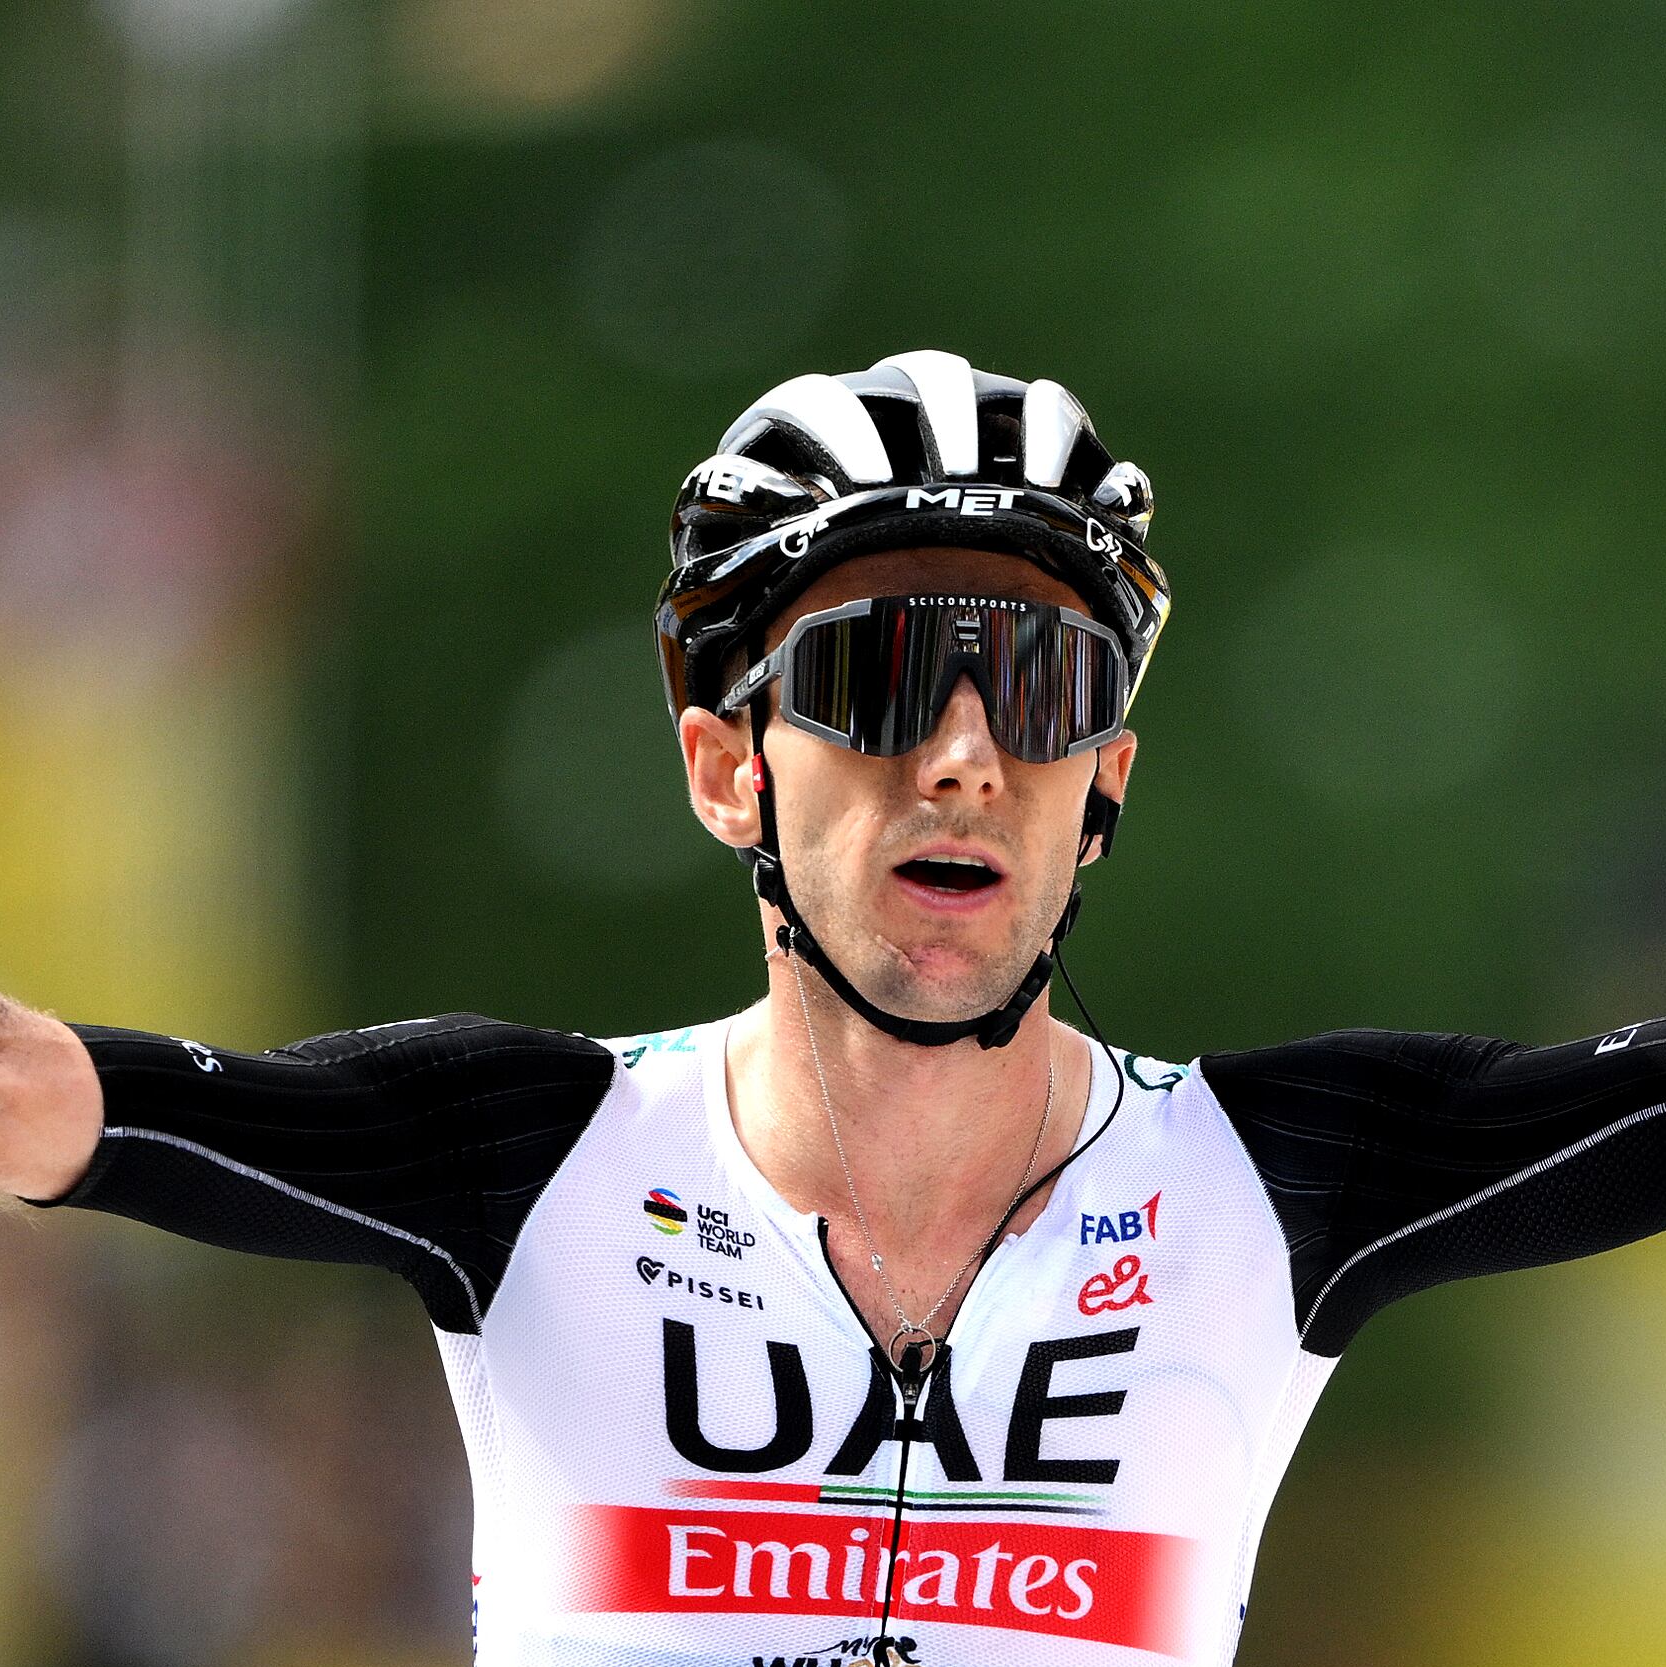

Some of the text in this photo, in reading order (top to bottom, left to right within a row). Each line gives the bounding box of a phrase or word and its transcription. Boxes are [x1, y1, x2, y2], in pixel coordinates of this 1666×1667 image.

[906, 488, 1024, 516] MET
[697, 1203, 729, 1227] UCI
[696, 1233, 743, 1260] TEAM
[697, 1219, 756, 1247] WORLD
[667, 1270, 764, 1311] PISSEI
[663, 1317, 1141, 1485] UAE
[666, 1524, 1098, 1621] Emirates
